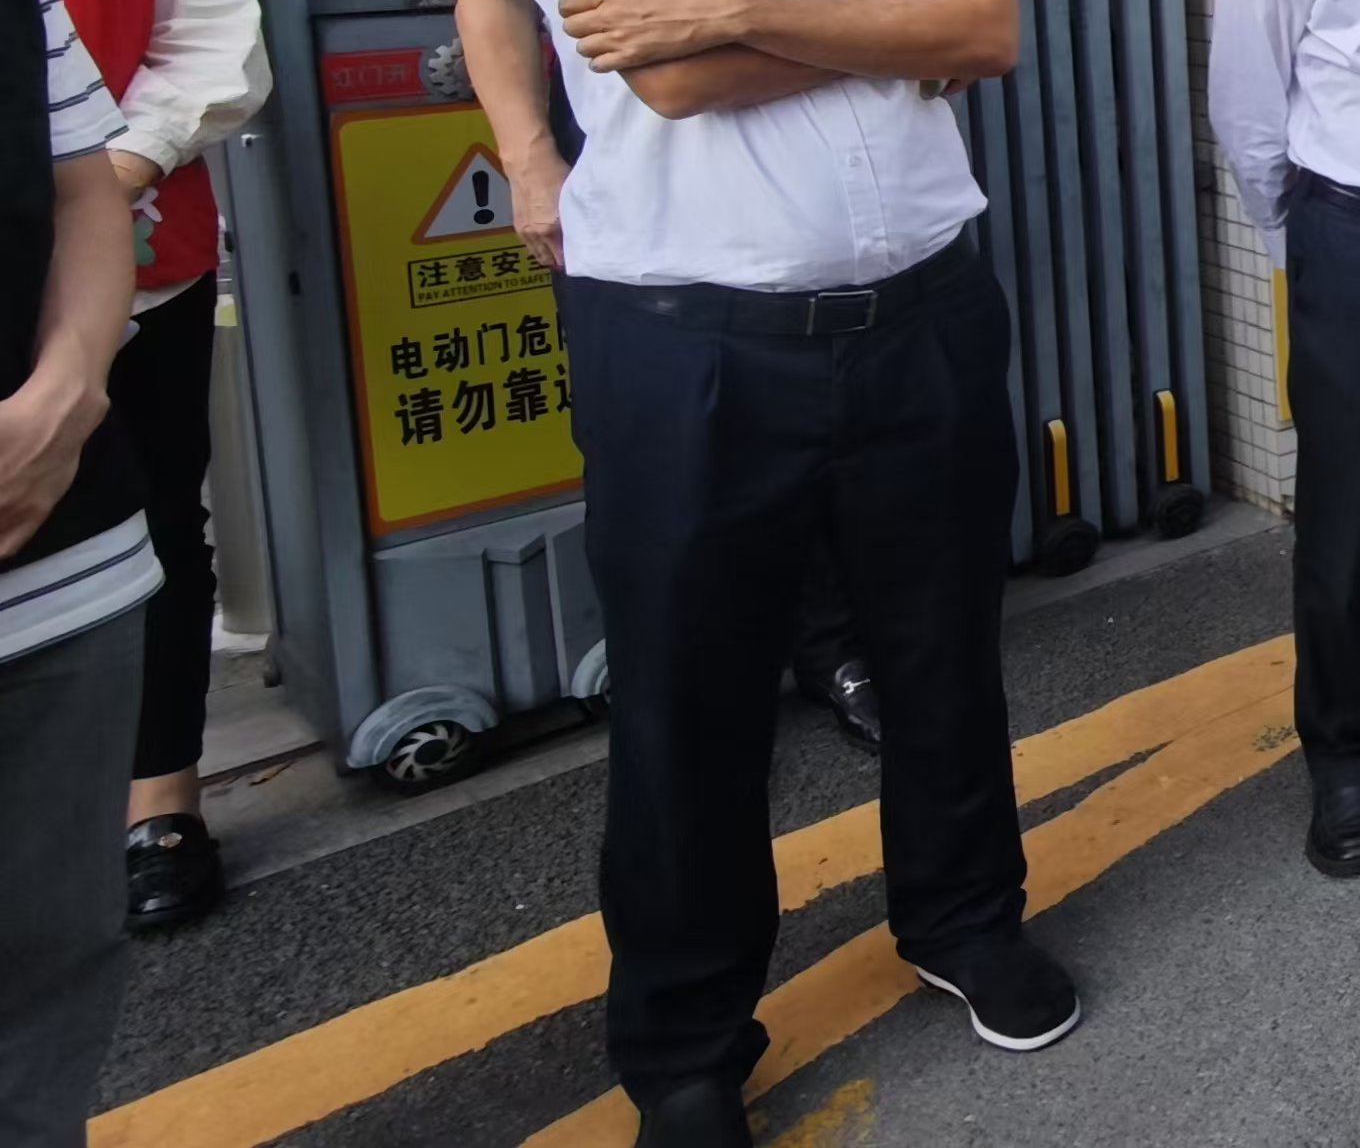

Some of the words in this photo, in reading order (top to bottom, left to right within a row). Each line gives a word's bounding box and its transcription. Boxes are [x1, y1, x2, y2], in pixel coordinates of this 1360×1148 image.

[418, 289, 440, 302] PAY
[443, 280, 505, 298] ATTENTION
[505, 278, 518, 289] TO
[520, 273, 550, 285] SAFET
[390, 312, 567, 379] 电动门危
